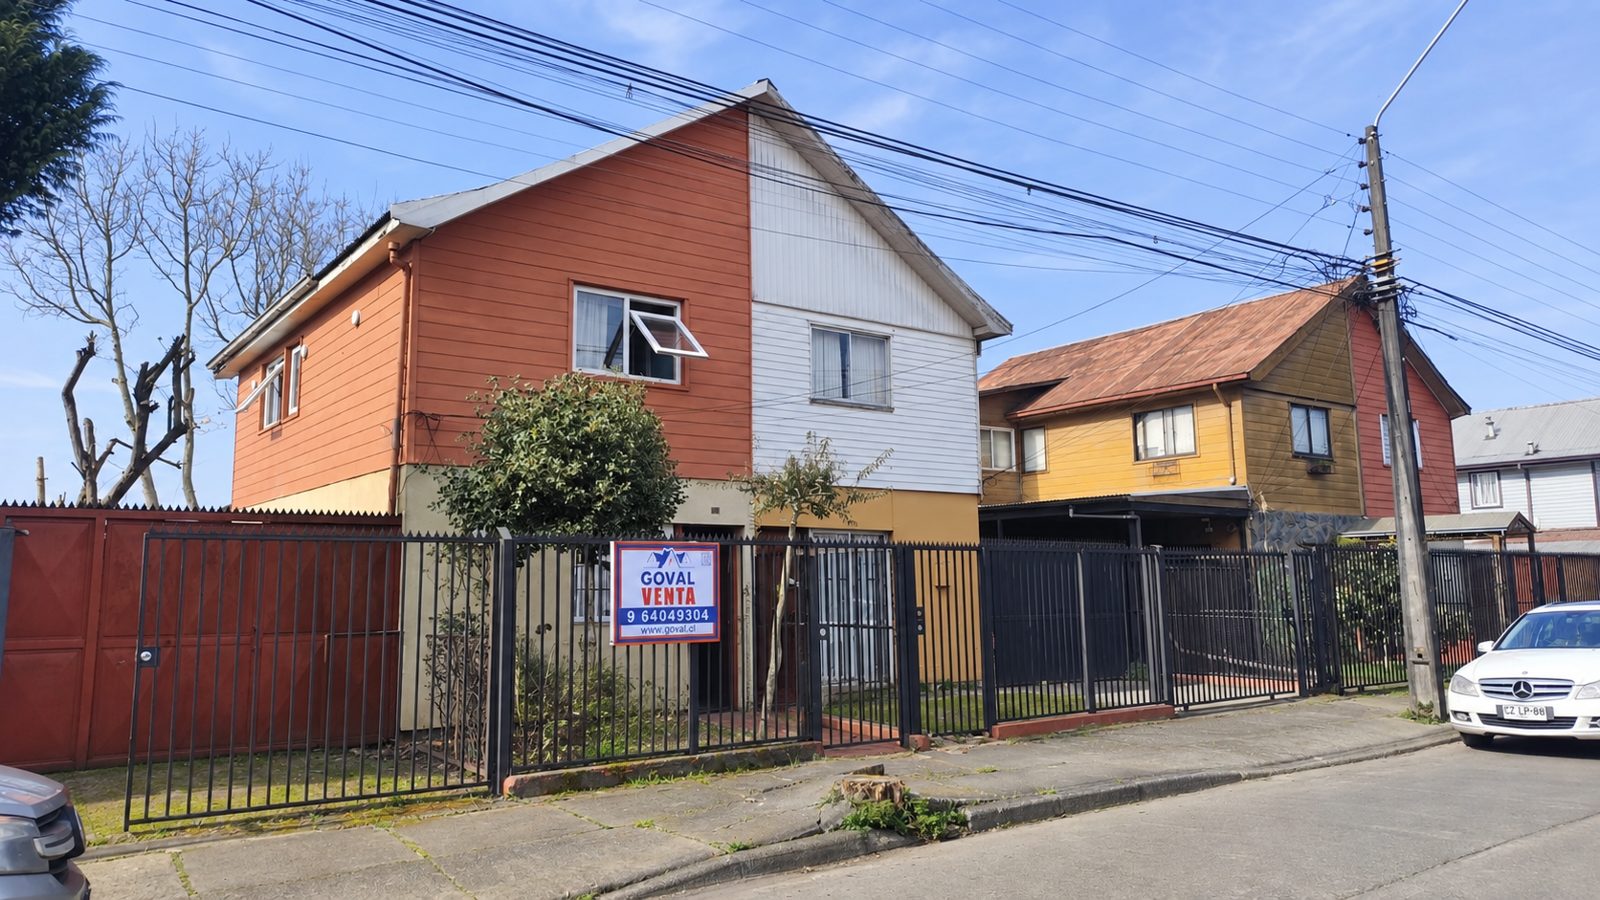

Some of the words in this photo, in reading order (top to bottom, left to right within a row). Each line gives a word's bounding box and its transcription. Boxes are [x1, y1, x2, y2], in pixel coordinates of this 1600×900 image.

[640, 571, 695, 585] GOVAL
[641, 587, 696, 606] VENTA
[627, 610, 635, 623] 9
[641, 609, 709, 623] 64049304
[640, 624, 696, 635] www.goval.cl
